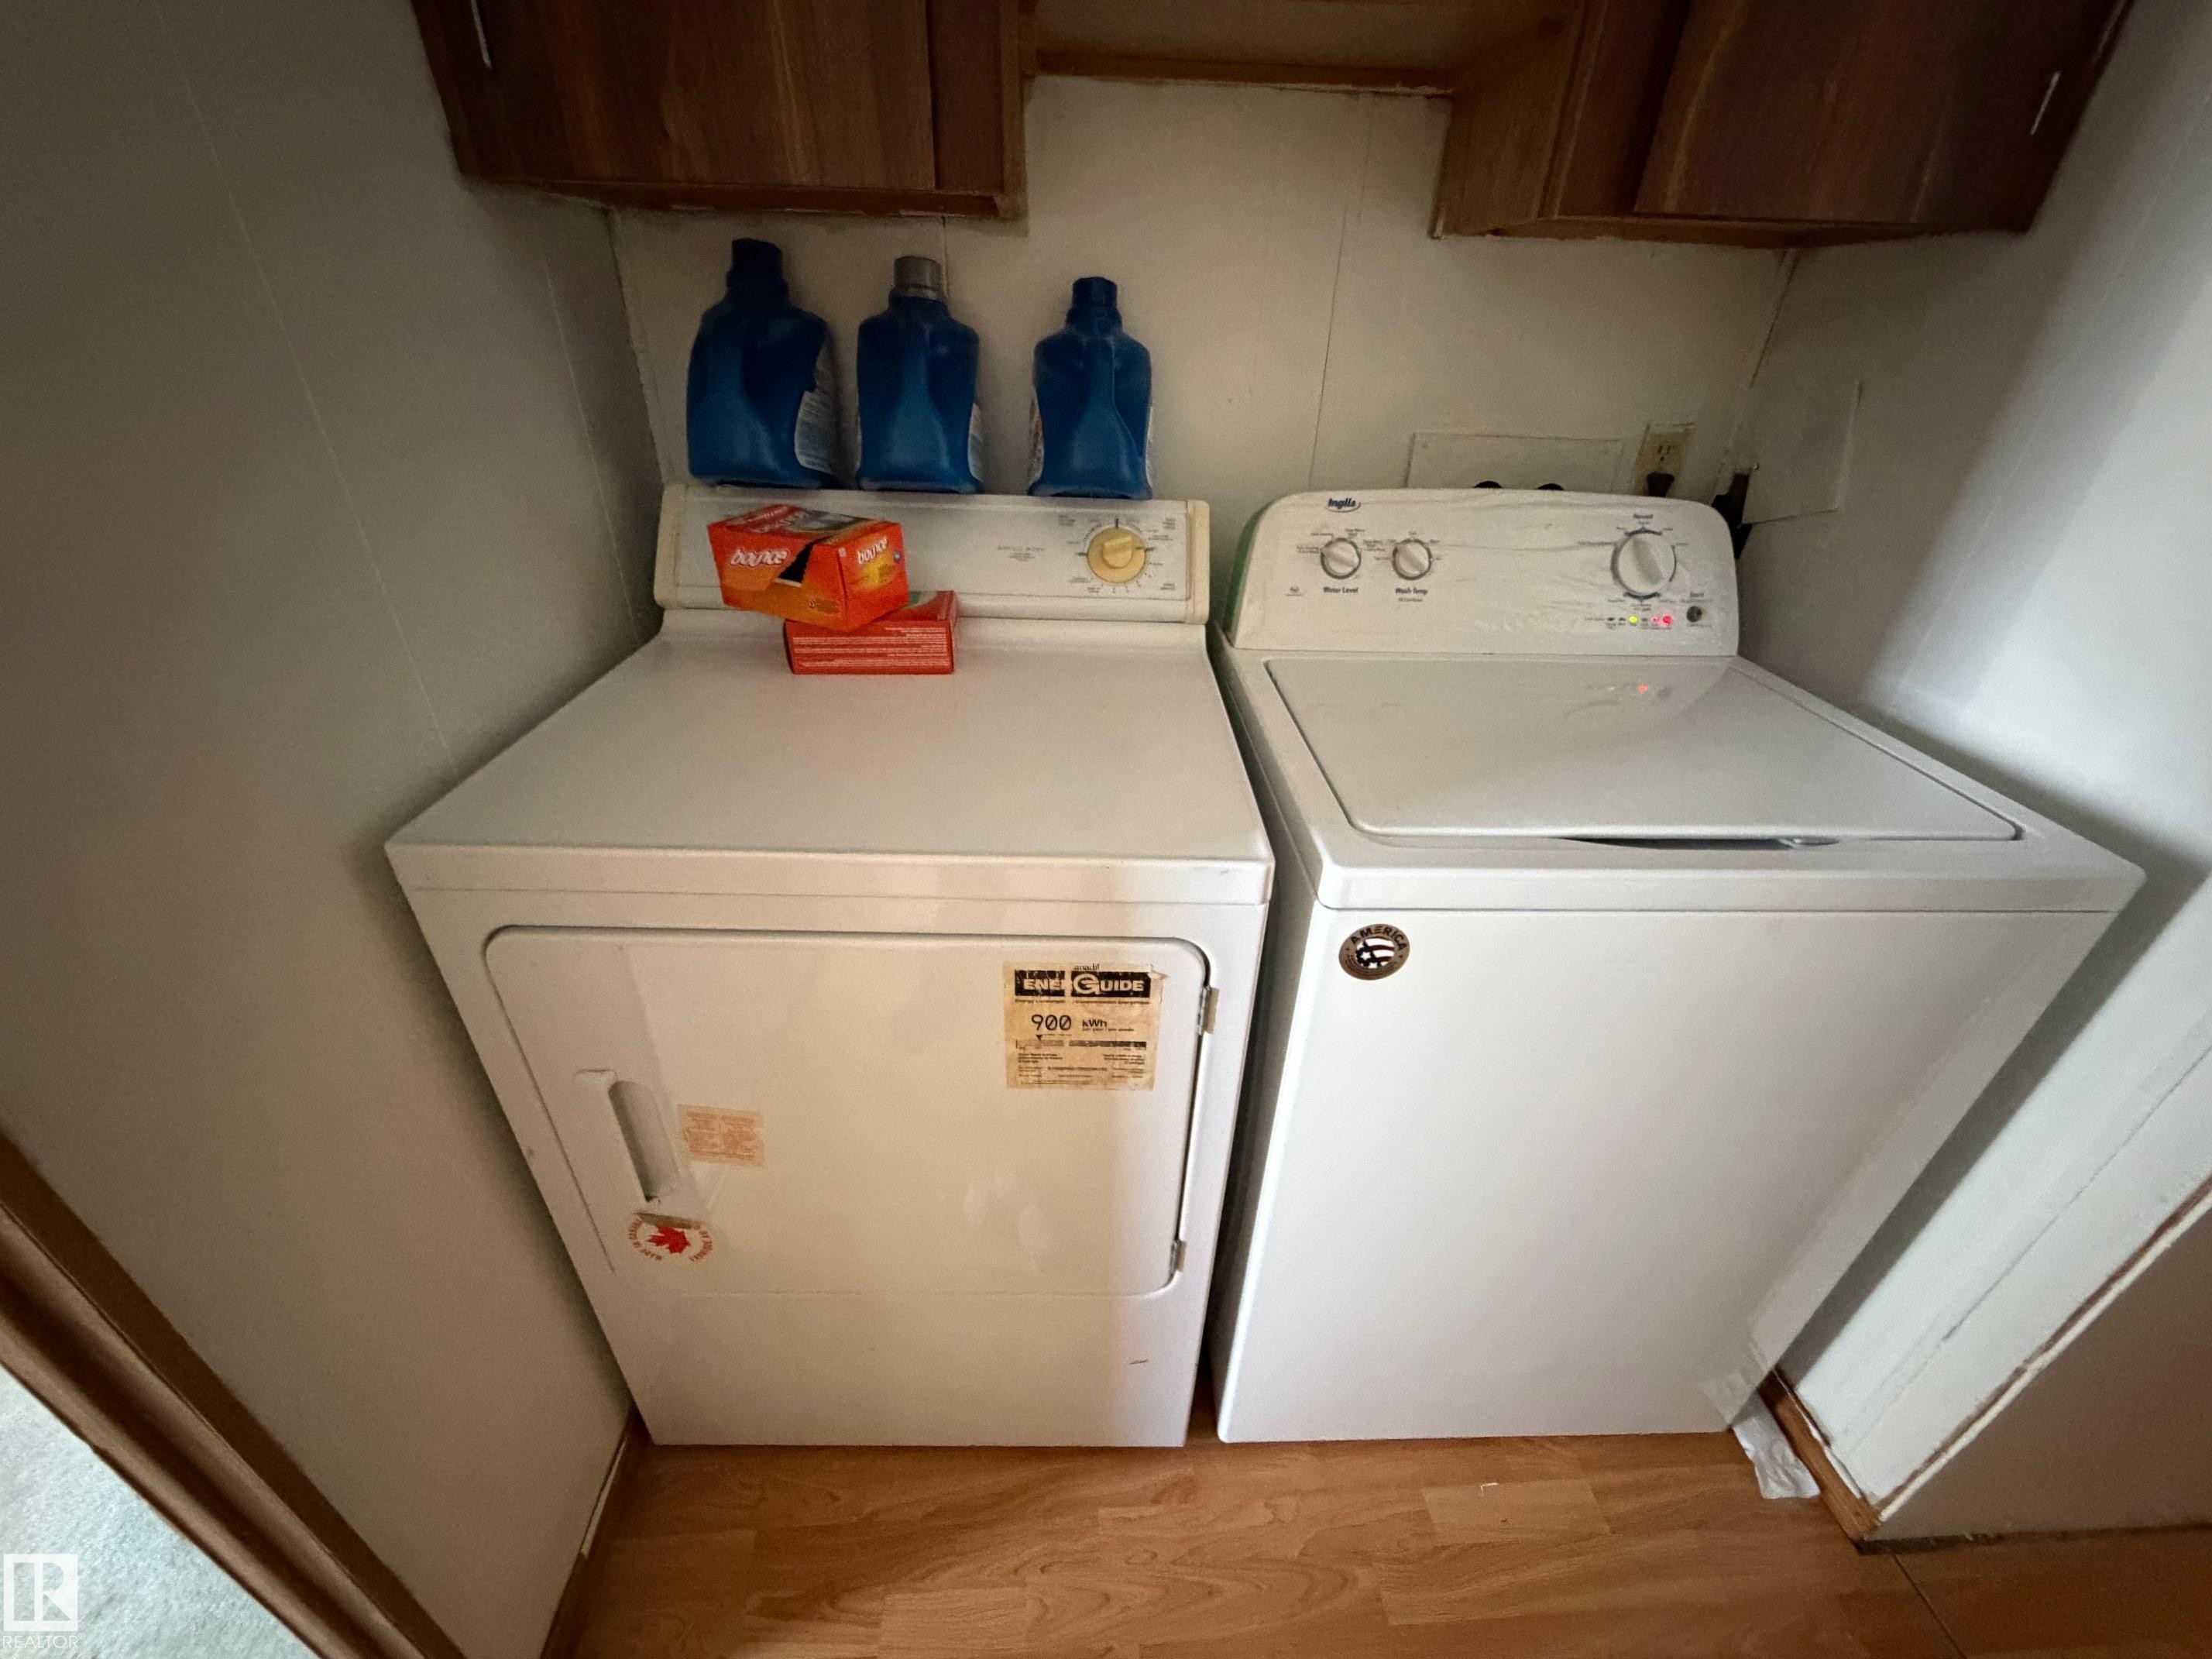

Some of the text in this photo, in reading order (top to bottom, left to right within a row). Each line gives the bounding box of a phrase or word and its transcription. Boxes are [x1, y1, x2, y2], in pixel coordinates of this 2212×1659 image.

[1328, 497, 1356, 509] Inglis
[1342, 586, 1358, 594] Level
[1351, 926, 1407, 951] AMERICA
[1031, 1014, 1072, 1031] 900
[1082, 1019, 1108, 1028] kWh
